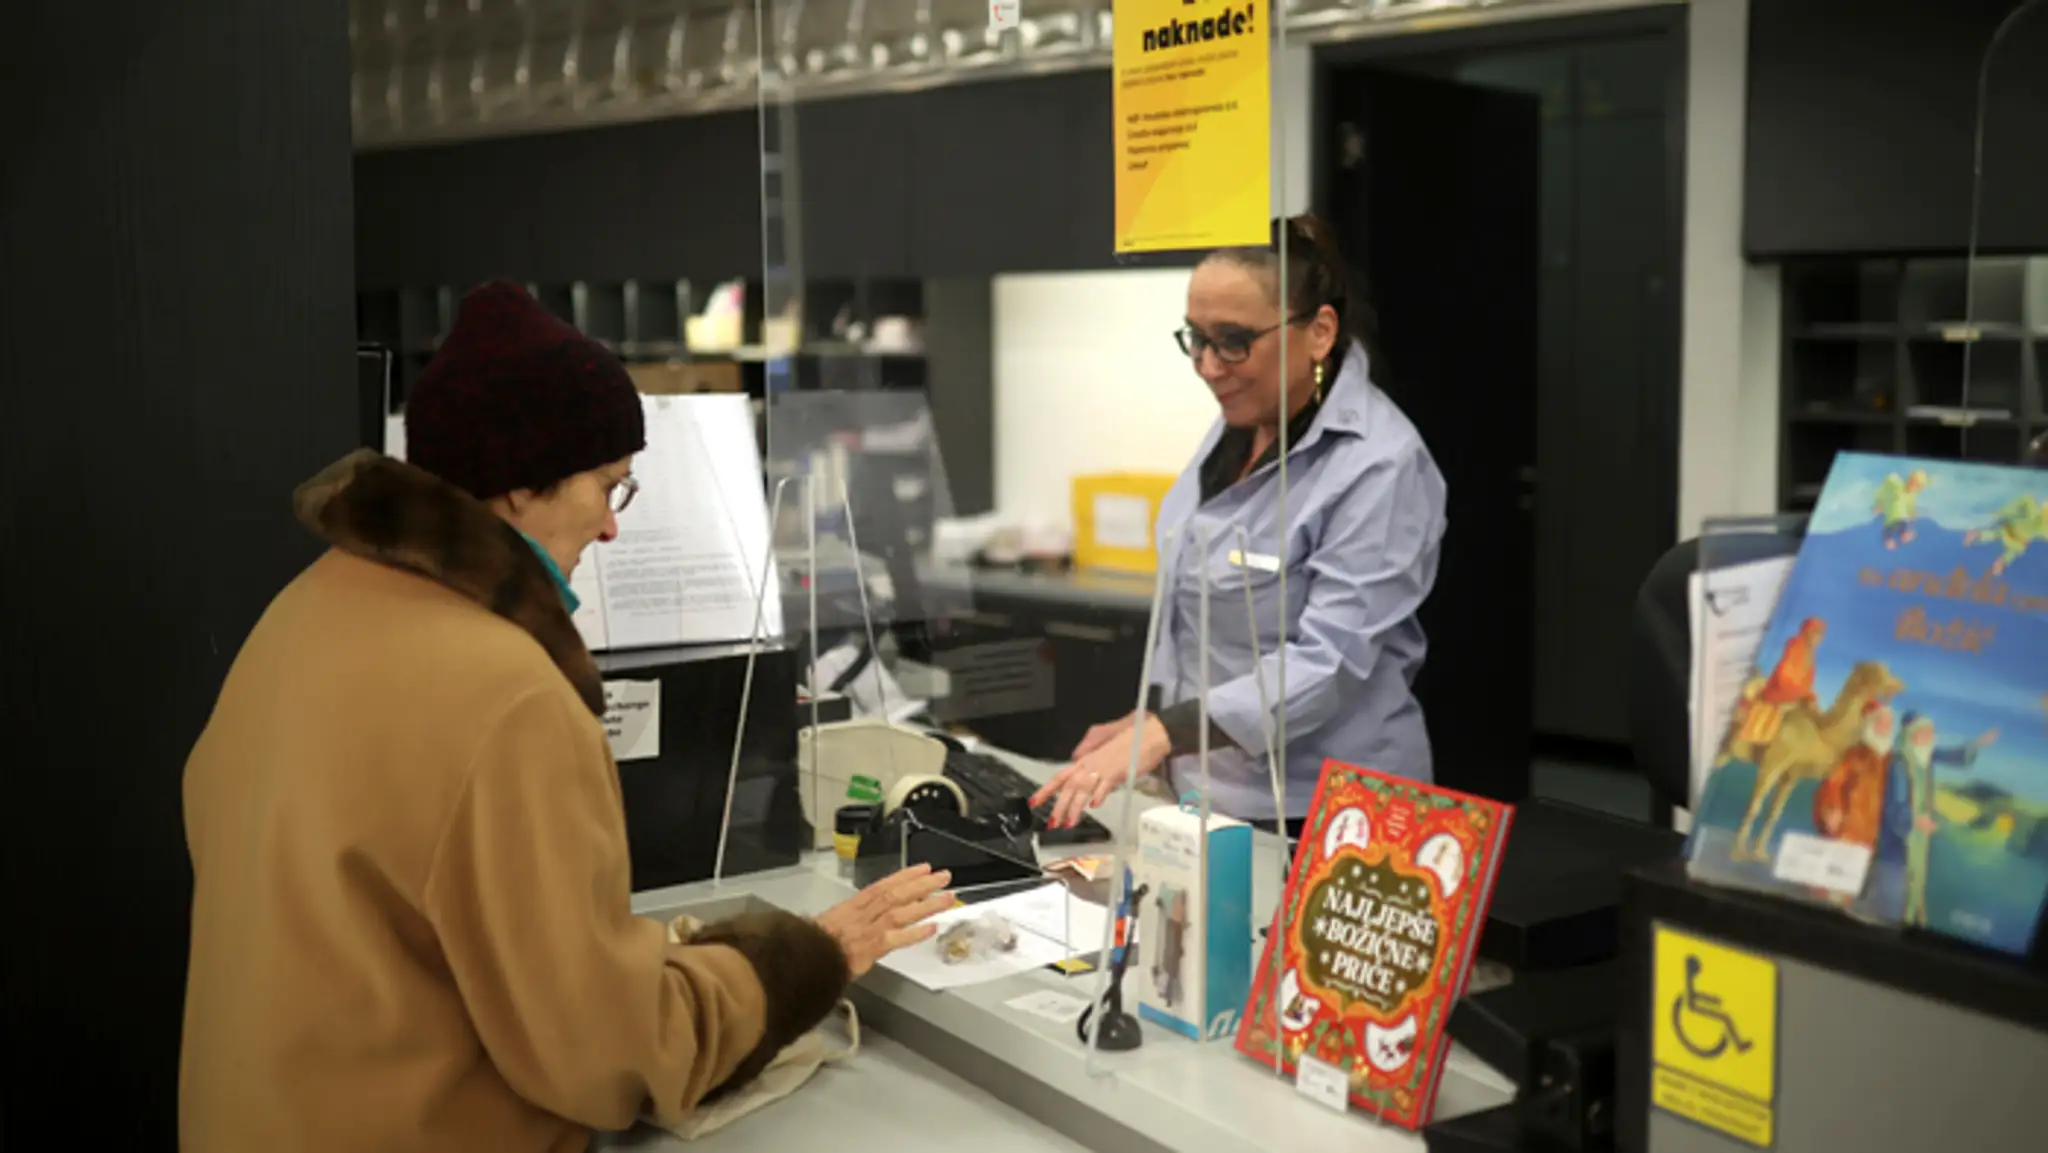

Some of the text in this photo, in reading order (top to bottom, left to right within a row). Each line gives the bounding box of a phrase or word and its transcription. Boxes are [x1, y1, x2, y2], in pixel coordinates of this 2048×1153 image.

[1143, 3, 1254, 53] naknade!
[1322, 885, 1438, 947] NAJLJEPŠE
[1325, 916, 1418, 971] BOŽIČNE
[1331, 950, 1395, 996] PRIČE
